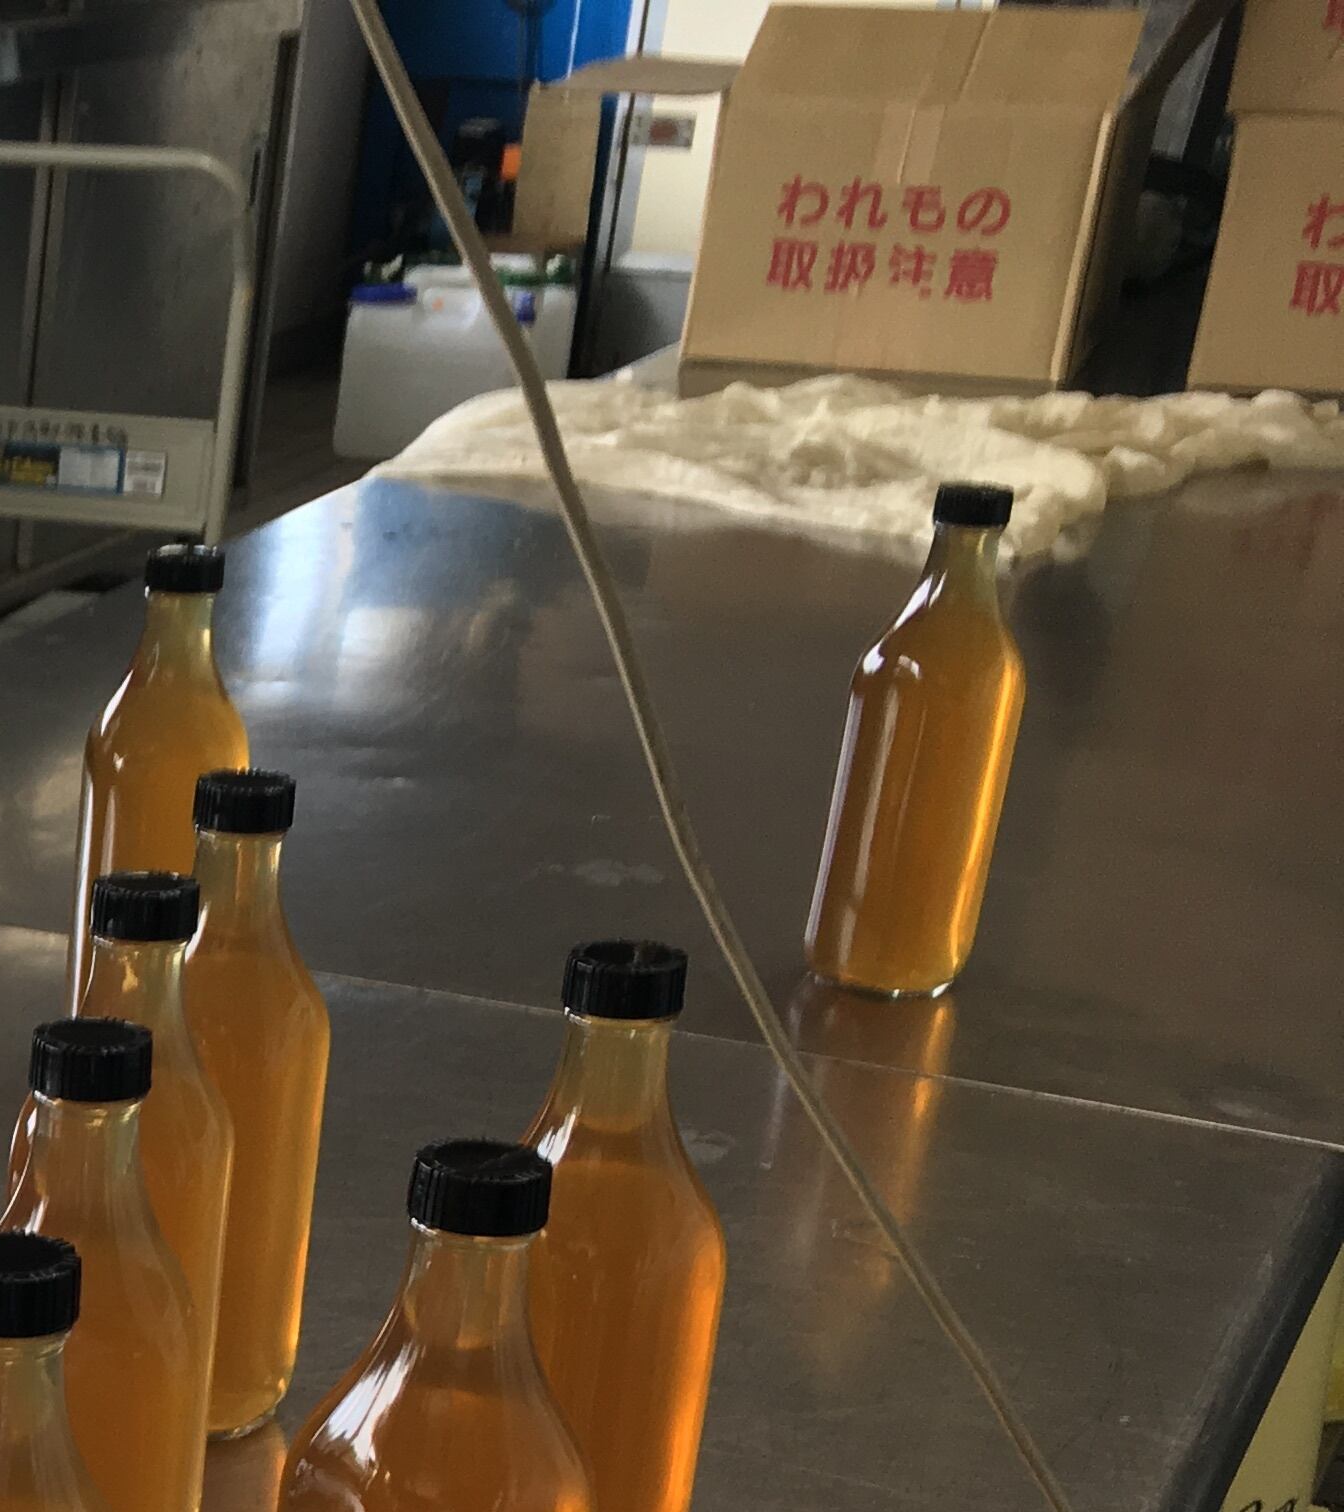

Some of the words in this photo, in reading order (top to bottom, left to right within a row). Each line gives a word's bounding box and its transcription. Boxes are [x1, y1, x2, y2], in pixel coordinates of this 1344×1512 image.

[777, 175, 1011, 236] われもの
[766, 238, 999, 300] 取扱注意
